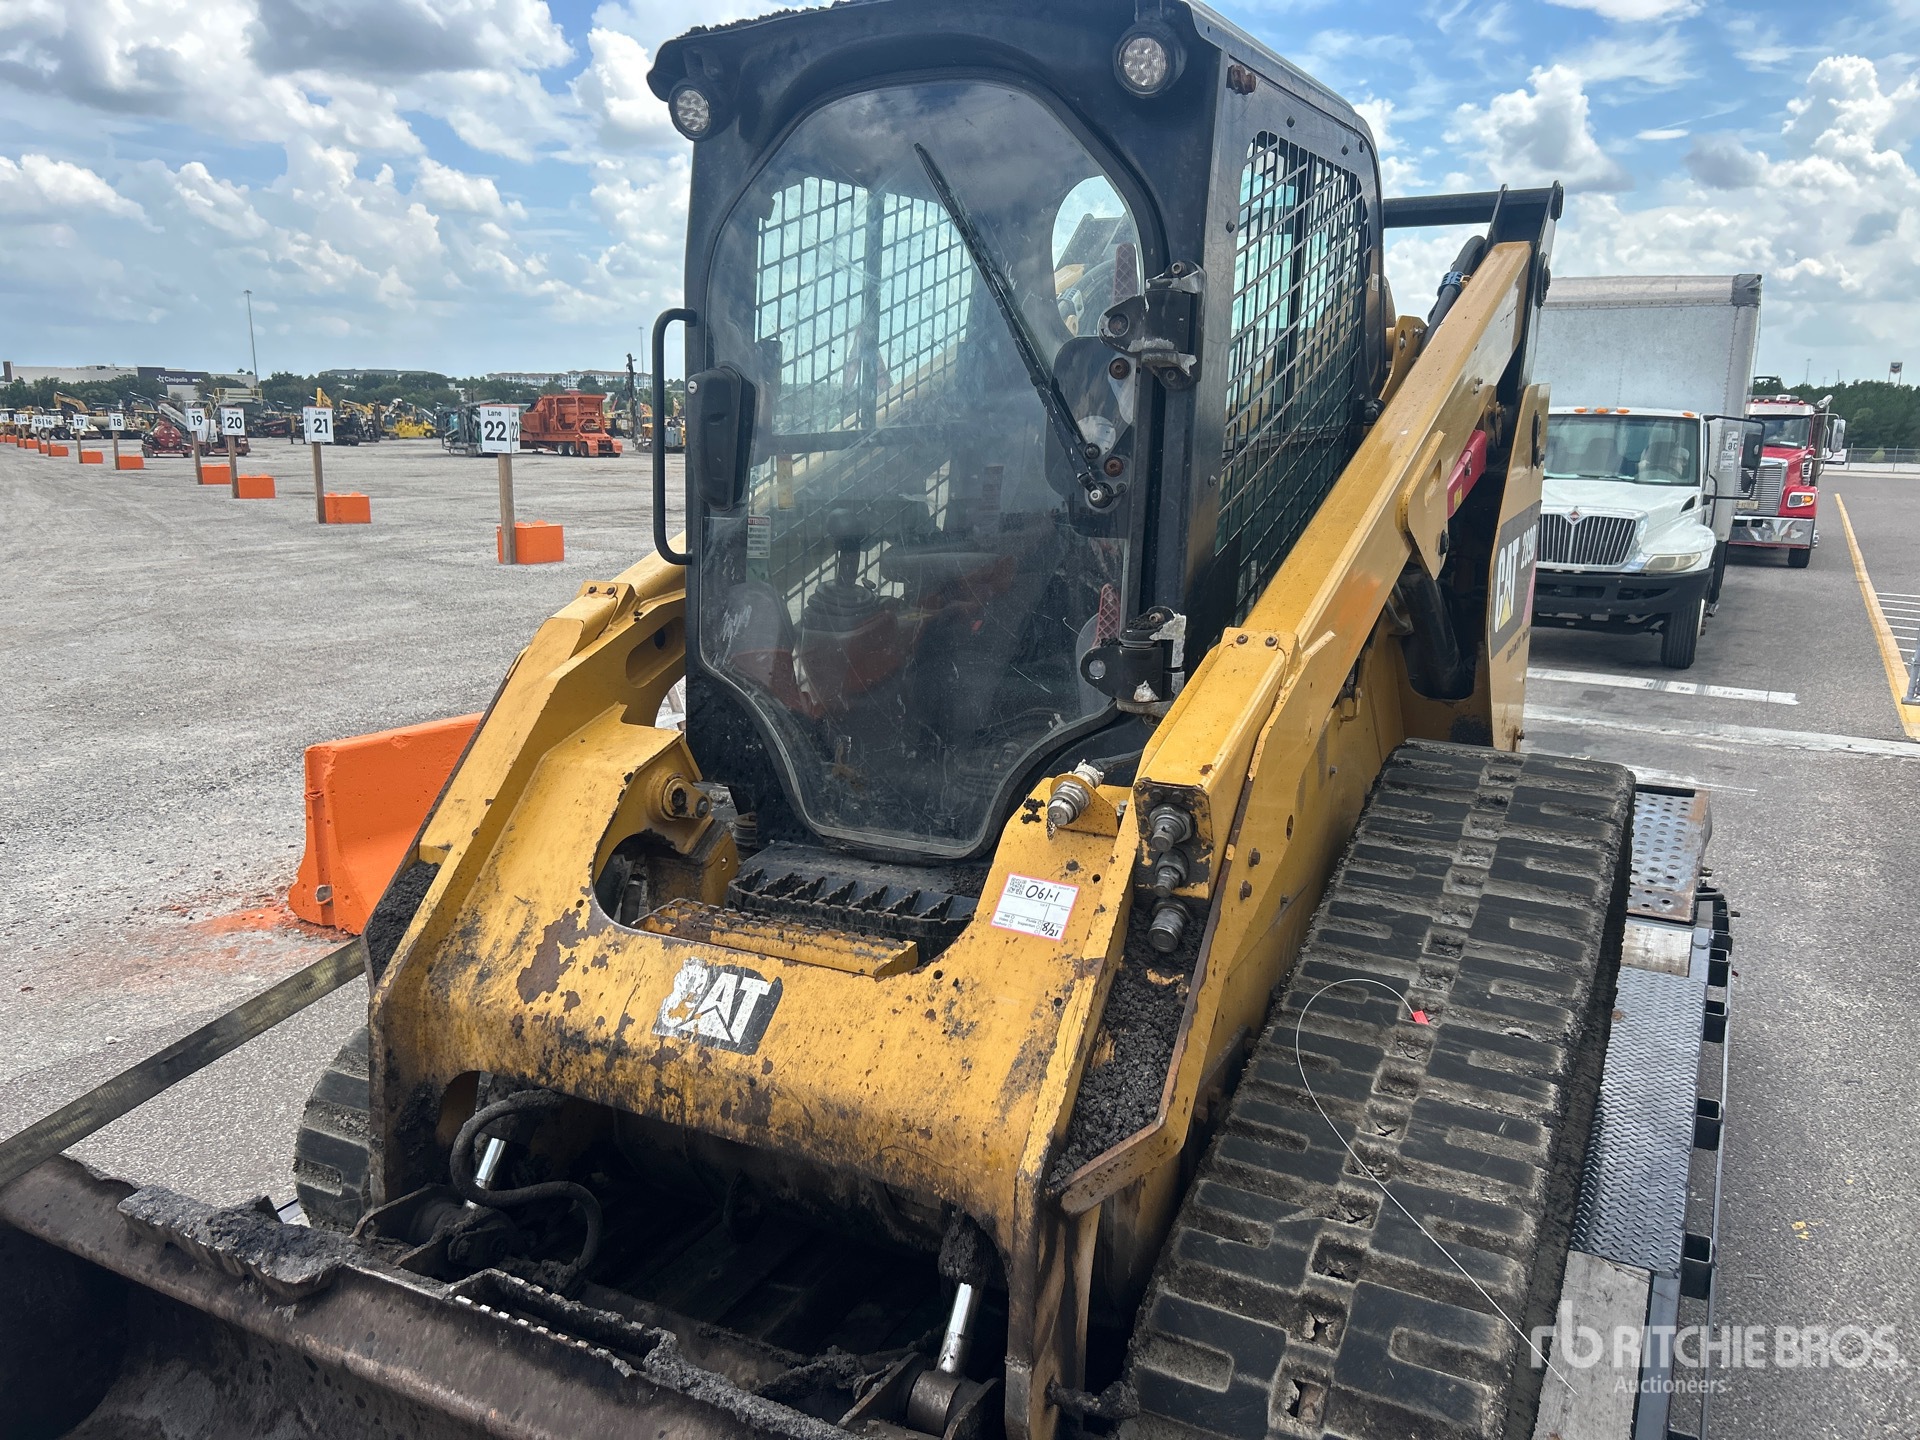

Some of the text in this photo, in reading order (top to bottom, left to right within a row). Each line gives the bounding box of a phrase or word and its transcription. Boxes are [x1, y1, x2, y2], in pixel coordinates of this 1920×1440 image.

[75, 418, 84, 426] 17
[112, 418, 122, 427] 18
[191, 415, 203, 426] 19
[226, 416, 243, 429] 20
[313, 417, 329, 434] 21
[484, 420, 507, 442] 22
[1494, 536, 1520, 634] CAT
[1041, 922, 1059, 937] 8/21
